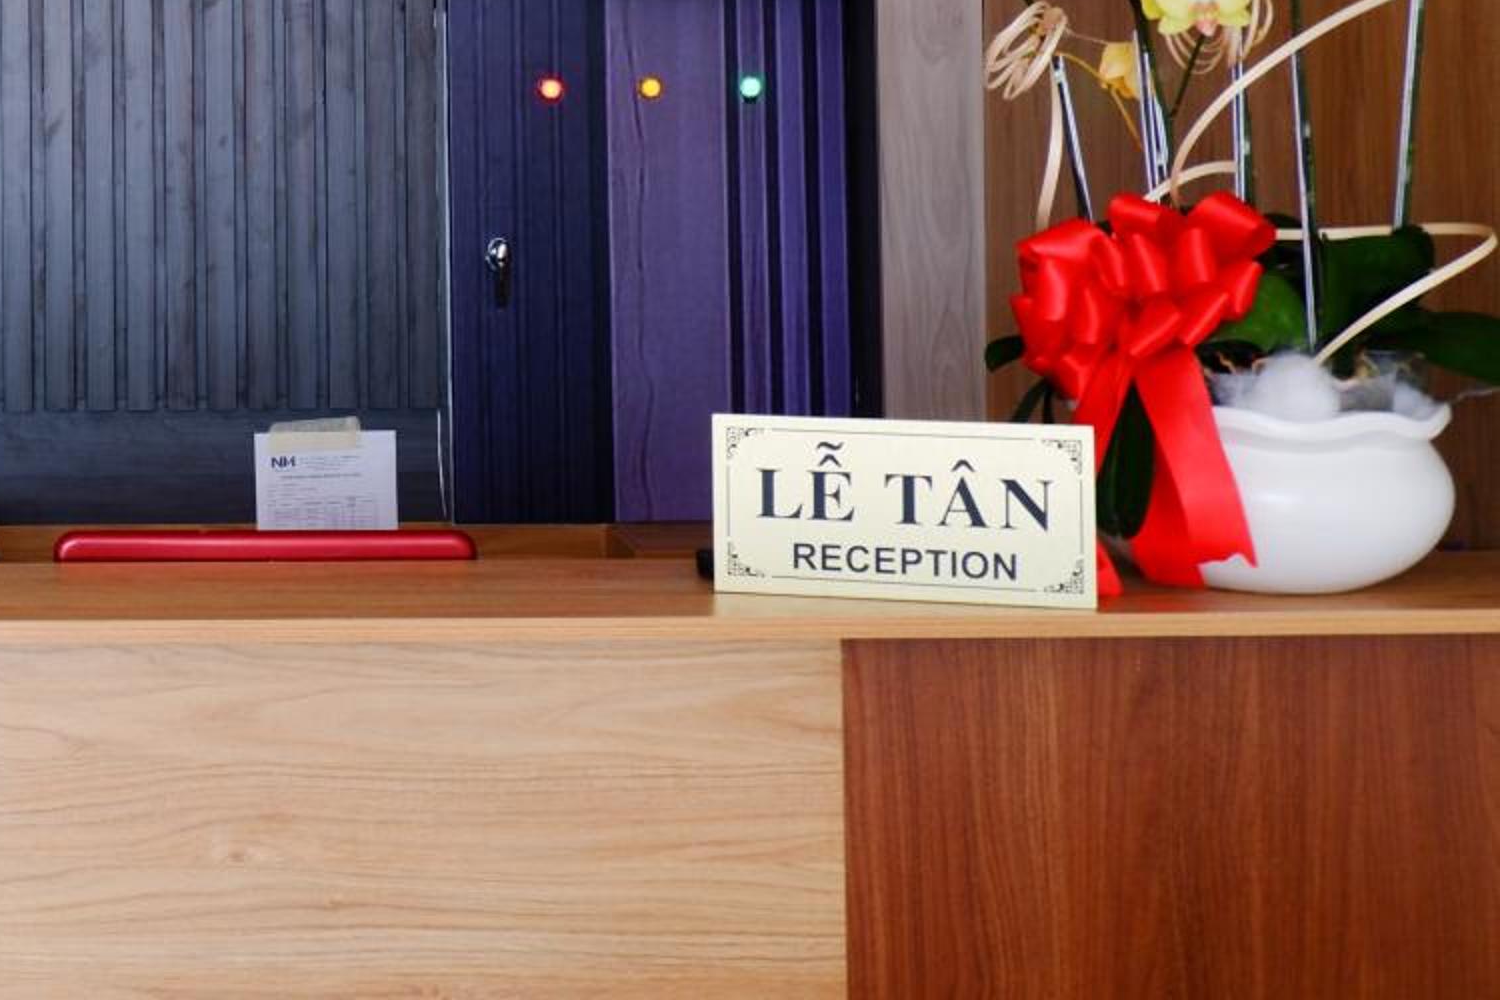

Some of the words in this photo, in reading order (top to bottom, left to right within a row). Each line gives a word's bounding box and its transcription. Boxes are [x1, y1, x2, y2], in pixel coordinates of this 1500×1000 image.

[756, 441, 855, 522] LỄ
[885, 459, 1055, 532] TÂN
[792, 543, 1018, 581] RECEPTION
